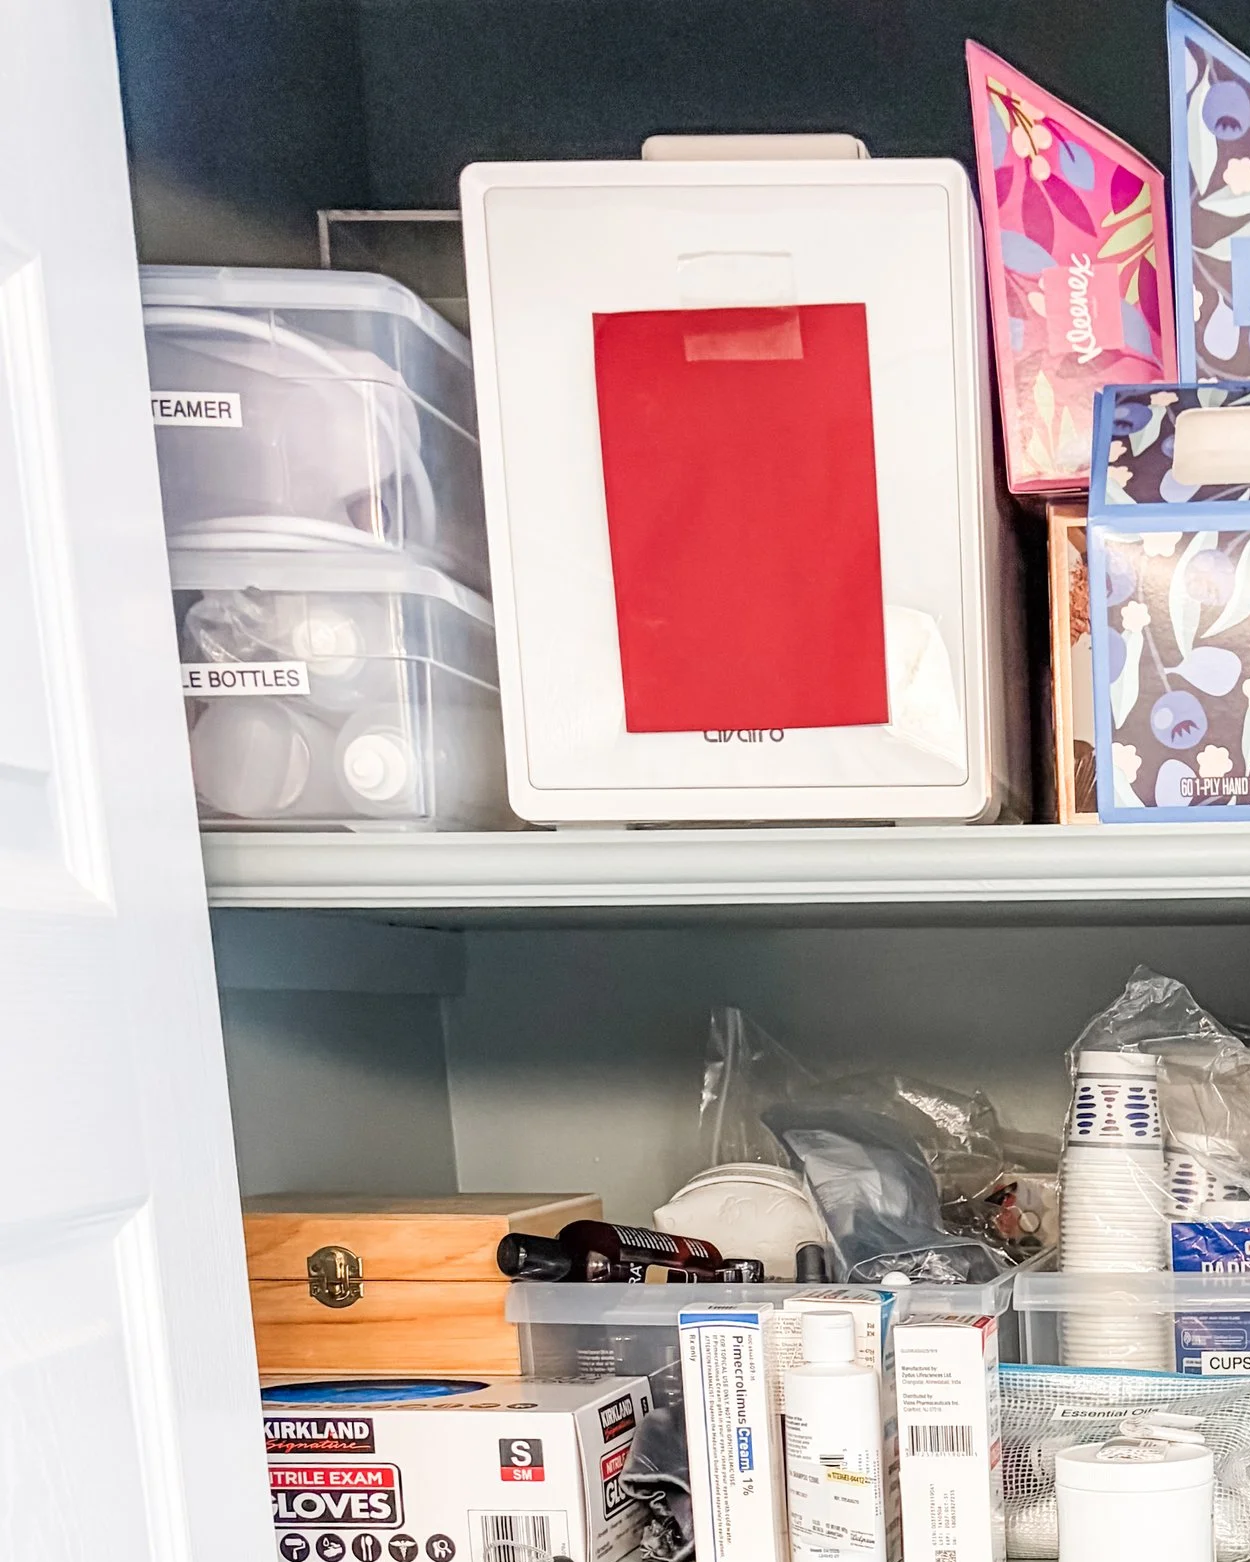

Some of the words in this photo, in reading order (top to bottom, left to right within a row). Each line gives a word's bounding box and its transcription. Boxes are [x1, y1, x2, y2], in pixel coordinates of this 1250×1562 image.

[1066, 253, 1104, 364] Kleenex
[208, 670, 301, 687] BOTTLES
[1180, 779, 1194, 797] 60
[1195, 778, 1221, 797] 1-PLY
[1222, 777, 1249, 796] HAND
[689, 1335, 697, 1344] Rx
[689, 1345, 697, 1362] only
[732, 1335, 748, 1425] Pimecrolimus
[599, 1397, 634, 1430] KIRKLAND
[1060, 1408, 1128, 1418] Essential
[1131, 1407, 1160, 1416] Oils
[263, 1421, 370, 1440] KIRKLAND
[266, 1439, 371, 1454] Signature
[510, 1440, 533, 1467] S
[738, 1428, 751, 1474] Cream,
[329, 1470, 383, 1486] EXAM
[512, 1469, 533, 1481] SM
[743, 1478, 754, 1496] 1%
